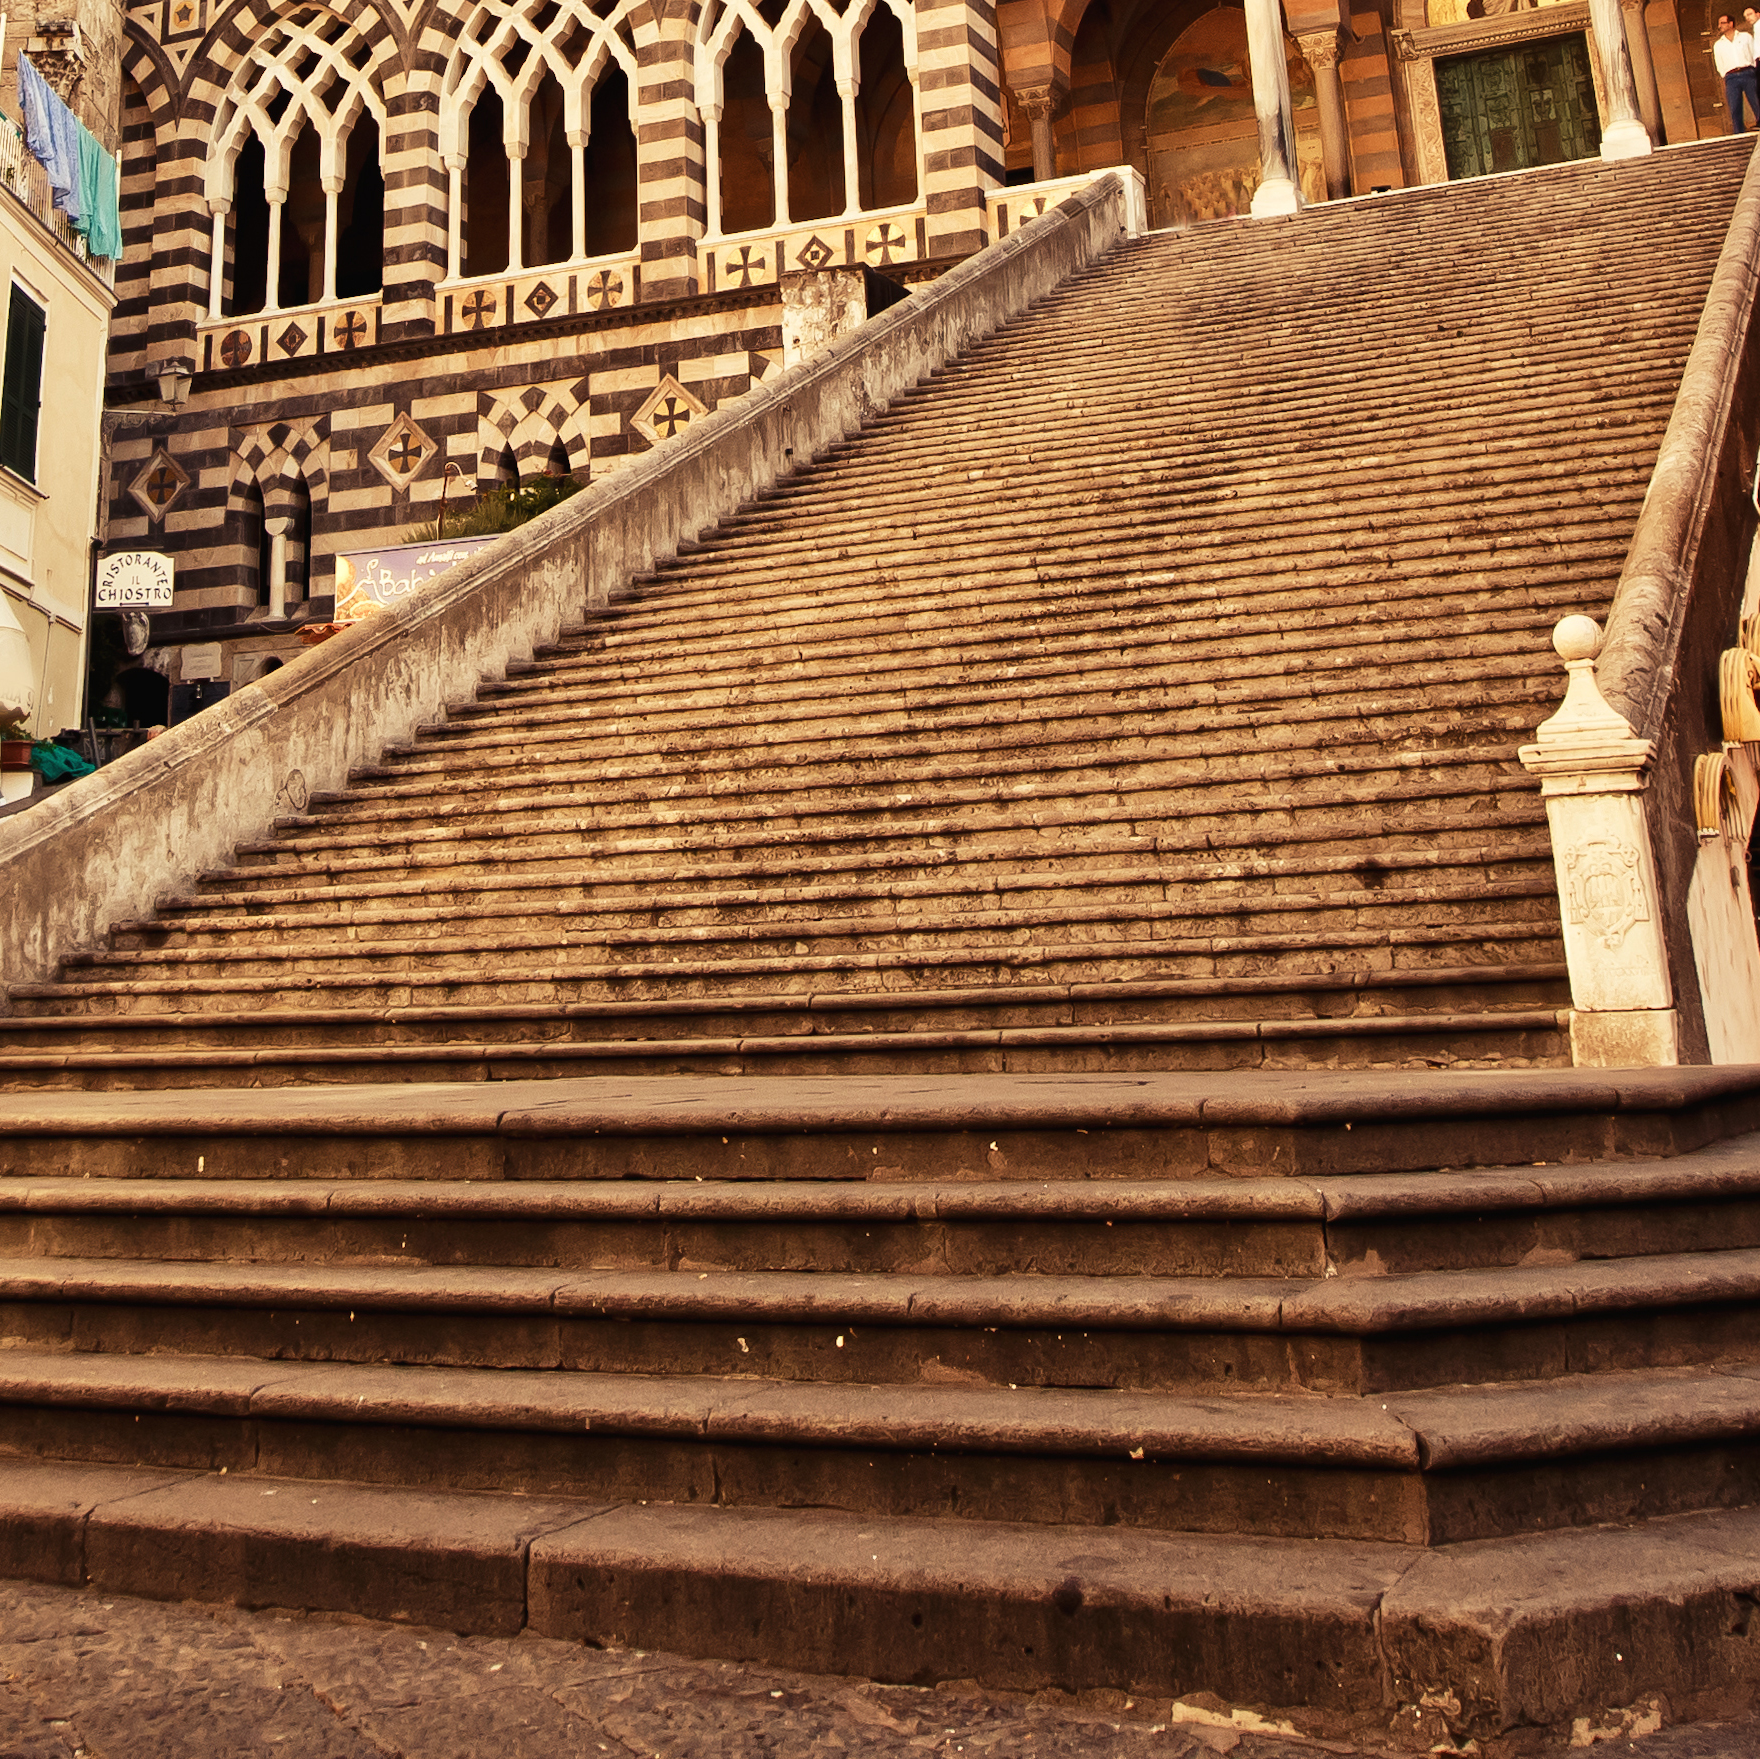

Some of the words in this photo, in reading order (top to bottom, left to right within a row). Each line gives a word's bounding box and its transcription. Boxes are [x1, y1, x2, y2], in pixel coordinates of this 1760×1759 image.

[102, 553, 169, 588] RISTORANTE
[131, 576, 140, 585] IL
[98, 587, 172, 601] CHIOSTRO
